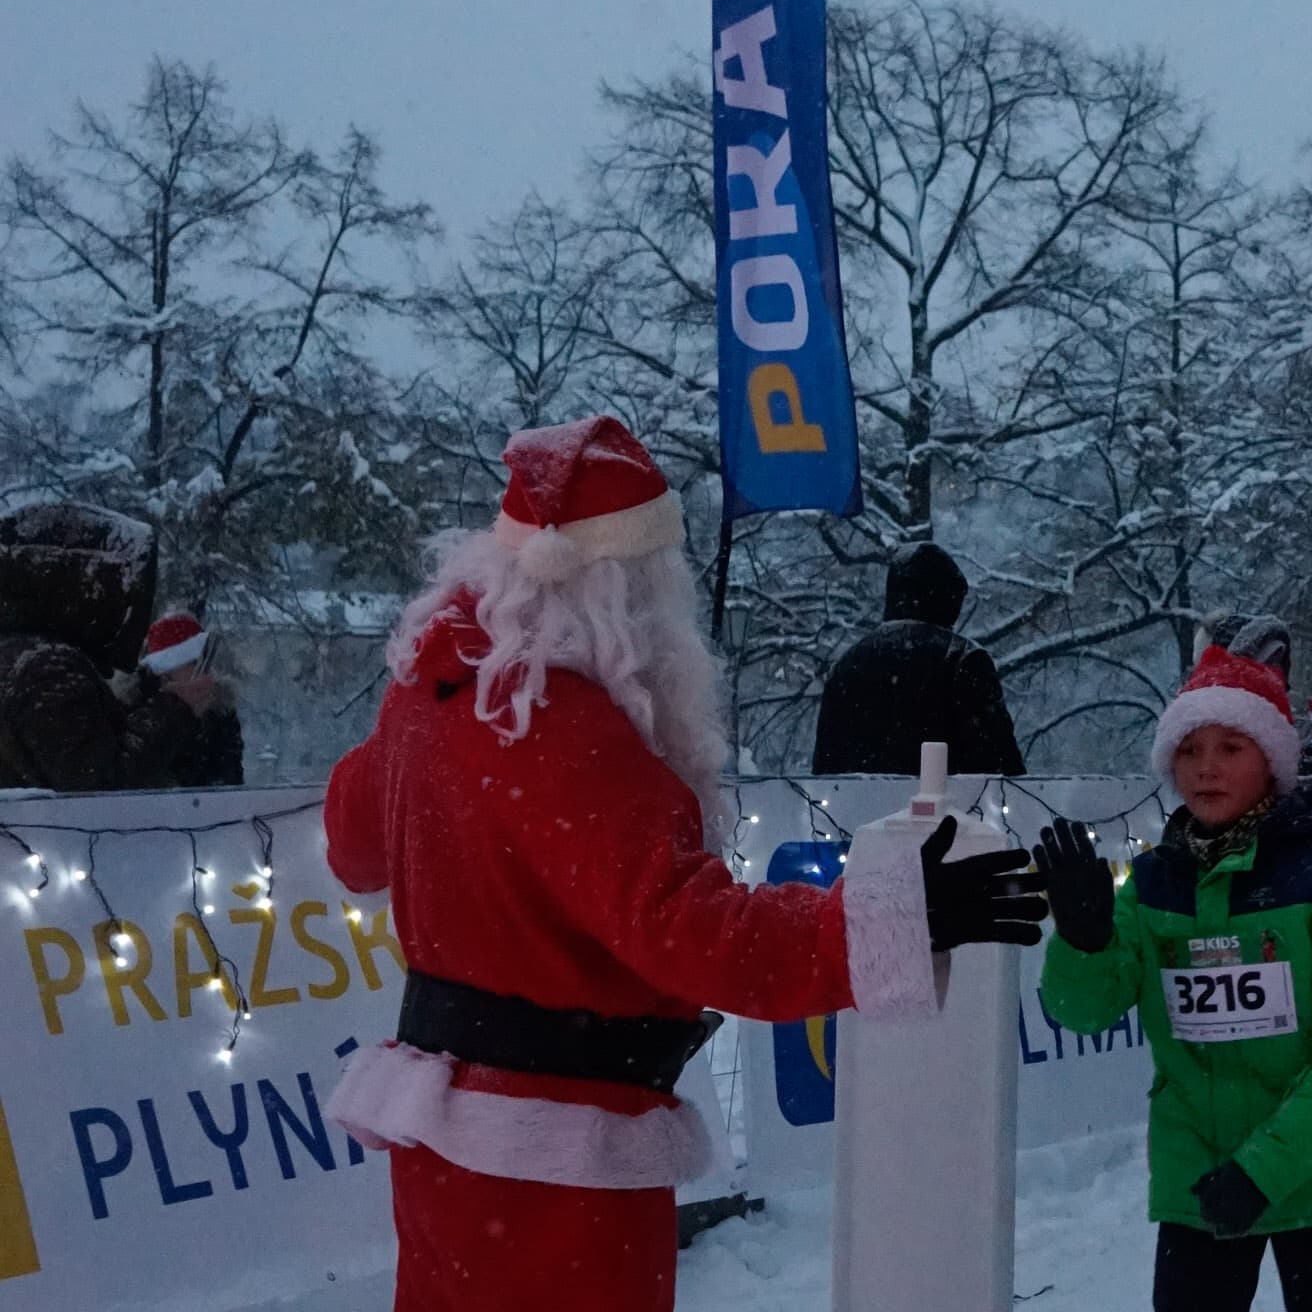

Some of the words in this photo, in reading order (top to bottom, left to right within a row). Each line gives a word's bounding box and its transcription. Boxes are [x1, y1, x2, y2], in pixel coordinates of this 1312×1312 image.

[1206, 936, 1240, 951] KIDS
[1174, 971, 1265, 1014] 3216
[70, 1037, 364, 1220] PLYN
